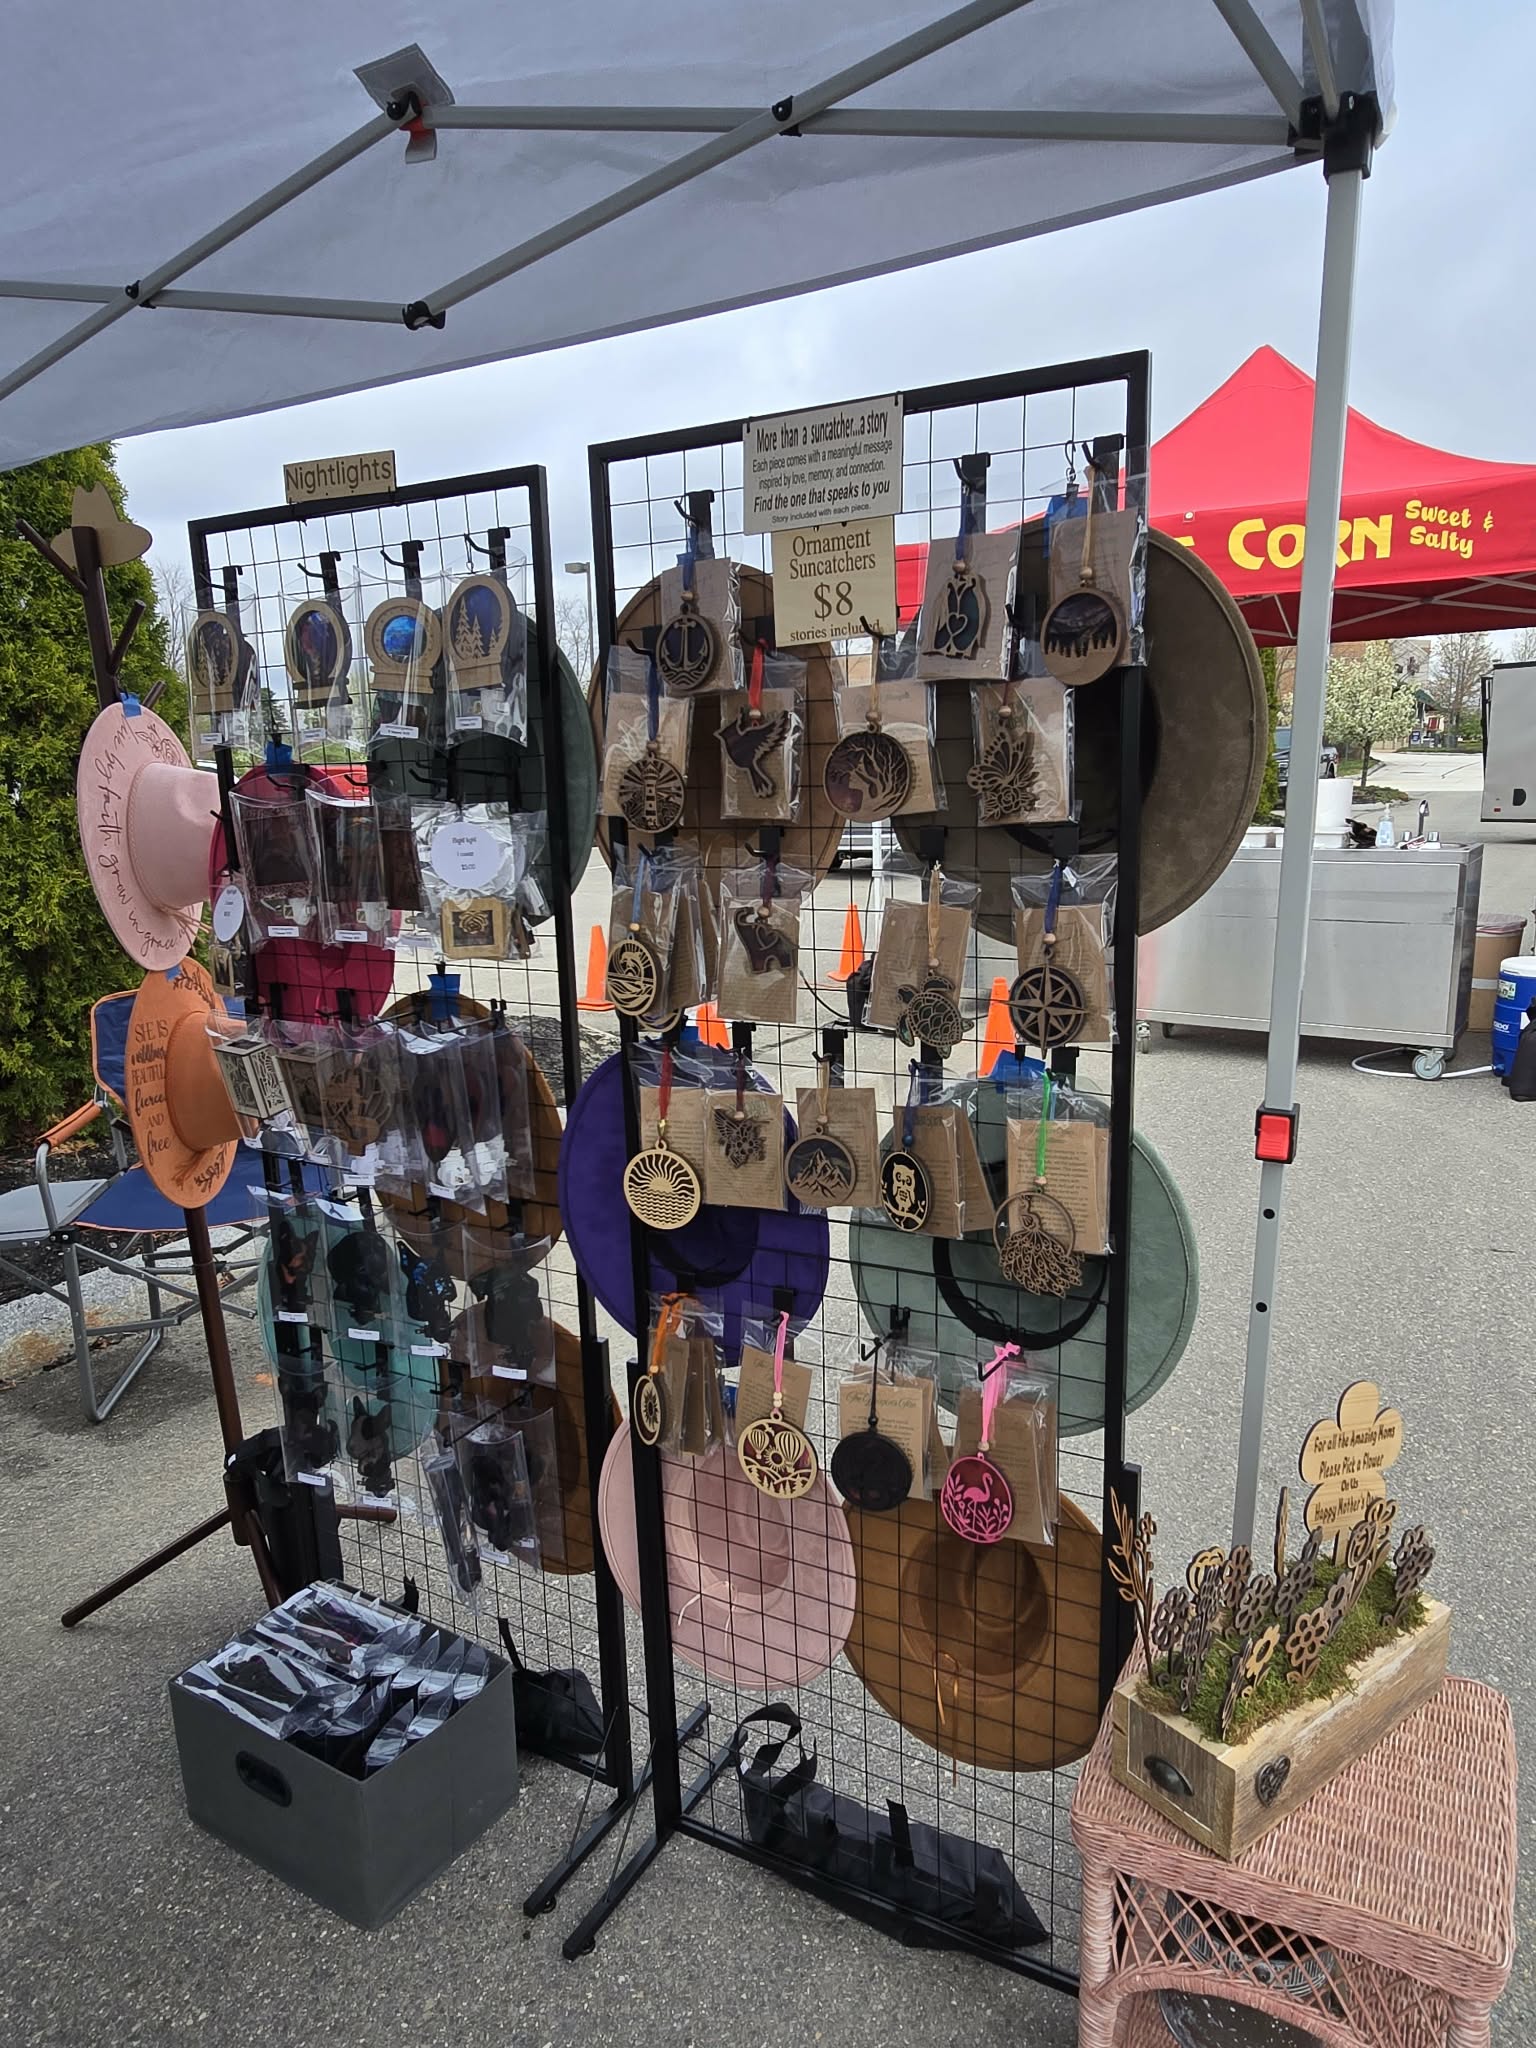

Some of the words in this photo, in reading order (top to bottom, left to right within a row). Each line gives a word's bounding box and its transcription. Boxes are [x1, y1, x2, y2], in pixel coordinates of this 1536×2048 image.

[757, 428, 777, 454] More
[781, 422, 798, 448] than
[802, 426, 808, 444] a
[867, 410, 889, 438] story
[752, 459, 768, 473] Each
[769, 456, 786, 473] piece
[787, 454, 807, 468] comes
[808, 449, 821, 463] with
[822, 452, 827, 462] a
[827, 442, 862, 460] meaningful
[863, 439, 893, 455] message
[286, 457, 392, 494] Nightlights
[759, 475, 782, 490] inspired
[783, 473, 791, 489] by
[836, 465, 848, 479] and
[754, 493, 773, 512] Find
[774, 491, 788, 509] the
[790, 492, 807, 507] one
[808, 487, 826, 505] that
[827, 482, 859, 505] speaks
[861, 481, 870, 497] to
[872, 480, 891, 500] you
[772, 514, 789, 524] Story
[790, 509, 818, 521] included
[818, 507, 832, 517] with
[833, 504, 850, 514] each
[1405, 500, 1474, 529] Sweet
[1483, 511, 1494, 533] &
[793, 528, 871, 557] Ornament
[1409, 526, 1475, 559] Salty
[790, 551, 876, 579] Suncatchers
[814, 581, 853, 622] $8
[790, 626, 827, 642] stories
[98, 854, 133, 905] grow
[135, 1021, 155, 1043] SHE
[156, 1019, 169, 1039] IS
[147, 1130, 171, 1166] free
[1314, 1436, 1326, 1453] For
[1327, 1433, 1338, 1450] all
[1338, 1431, 1350, 1449] the
[1350, 1427, 1378, 1448] Amazing
[1378, 1424, 1395, 1442] Moms
[1319, 1460, 1341, 1480] Please
[1342, 1455, 1356, 1475] Pick
[1356, 1459, 1362, 1472] a
[1362, 1452, 1384, 1470] Flower
[1341, 1479, 1350, 1492] On
[1350, 1477, 1359, 1489] Us
[1314, 1501, 1337, 1524] Happy
[1337, 1492, 1365, 1517] Mother's
